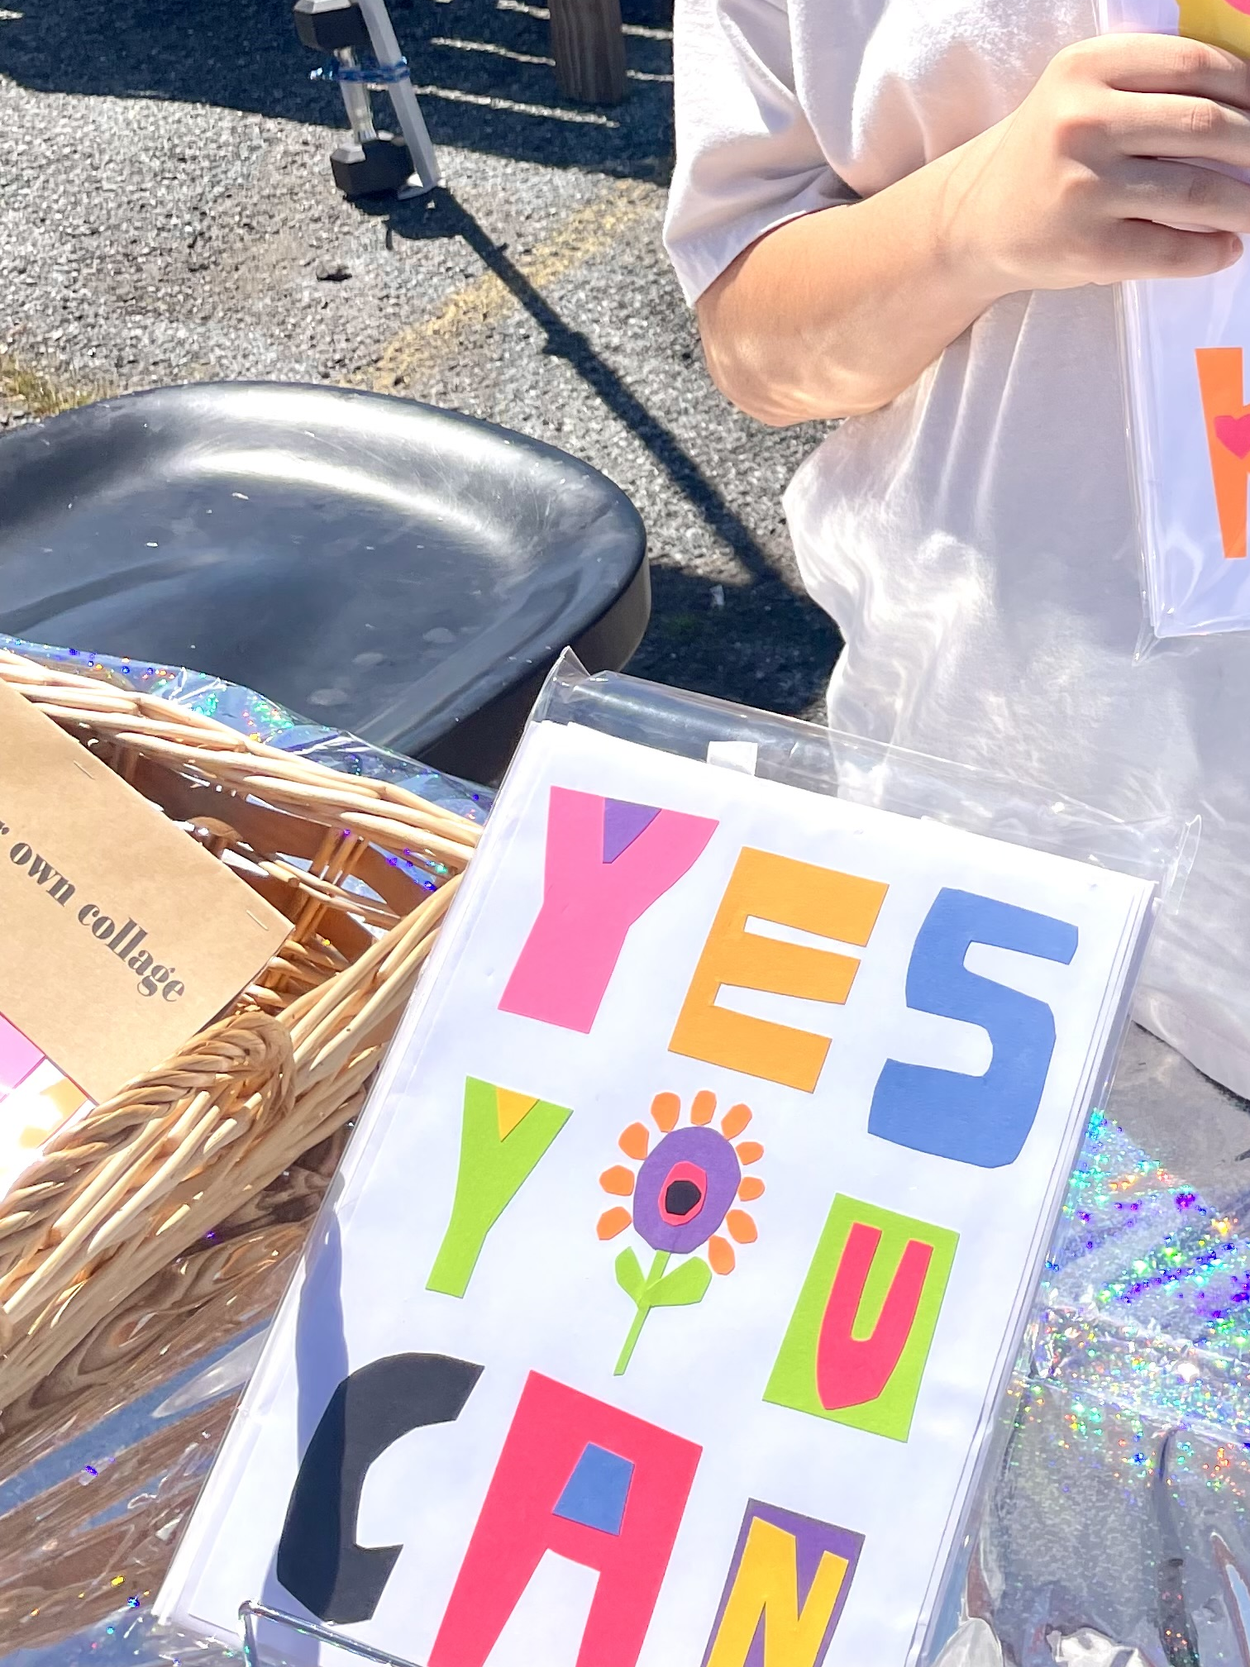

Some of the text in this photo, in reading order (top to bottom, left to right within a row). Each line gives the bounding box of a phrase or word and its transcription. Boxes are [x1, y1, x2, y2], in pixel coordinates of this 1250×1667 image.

[9, 842, 185, 1003] own collage
[497, 785, 1080, 1169] YES
[276, 1351, 866, 1667] CAN
